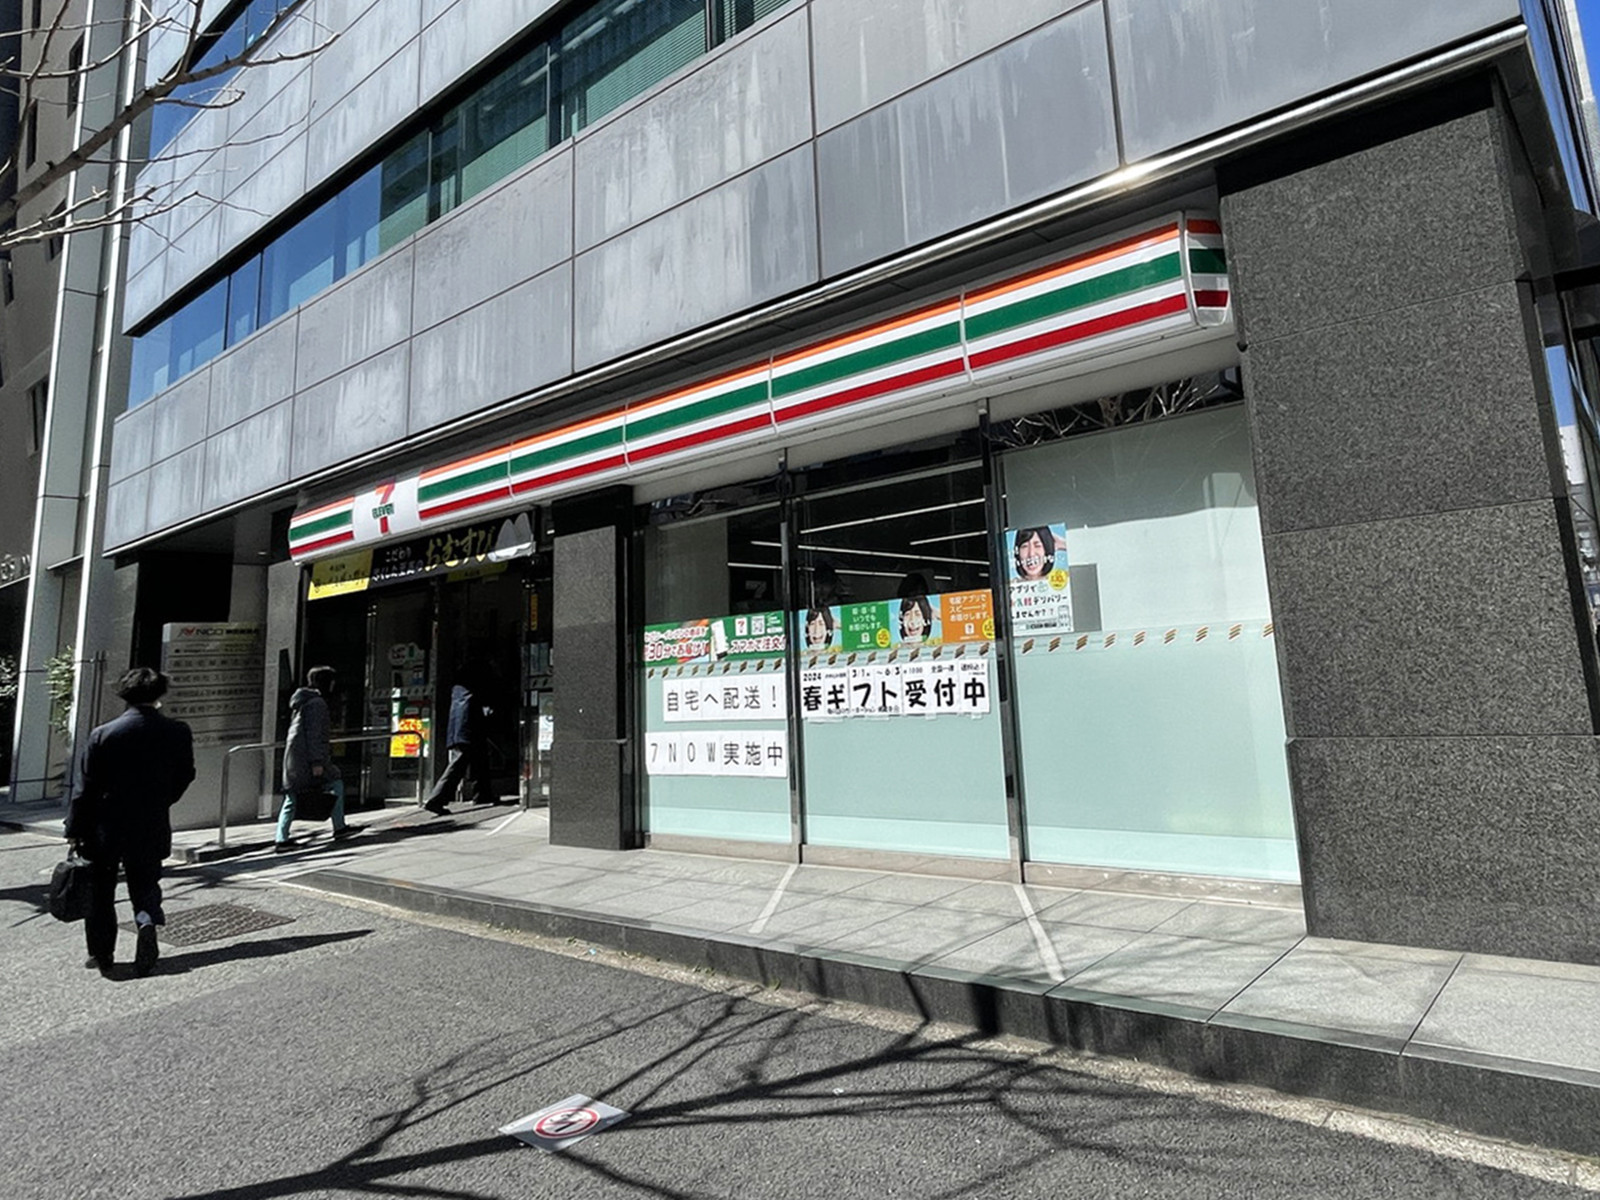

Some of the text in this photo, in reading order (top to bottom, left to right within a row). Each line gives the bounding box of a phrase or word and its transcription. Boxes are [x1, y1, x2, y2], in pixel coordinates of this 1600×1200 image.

[667, 685, 776, 711] 自宅へ配送！
[803, 677, 985, 711] 春ギフト受付中
